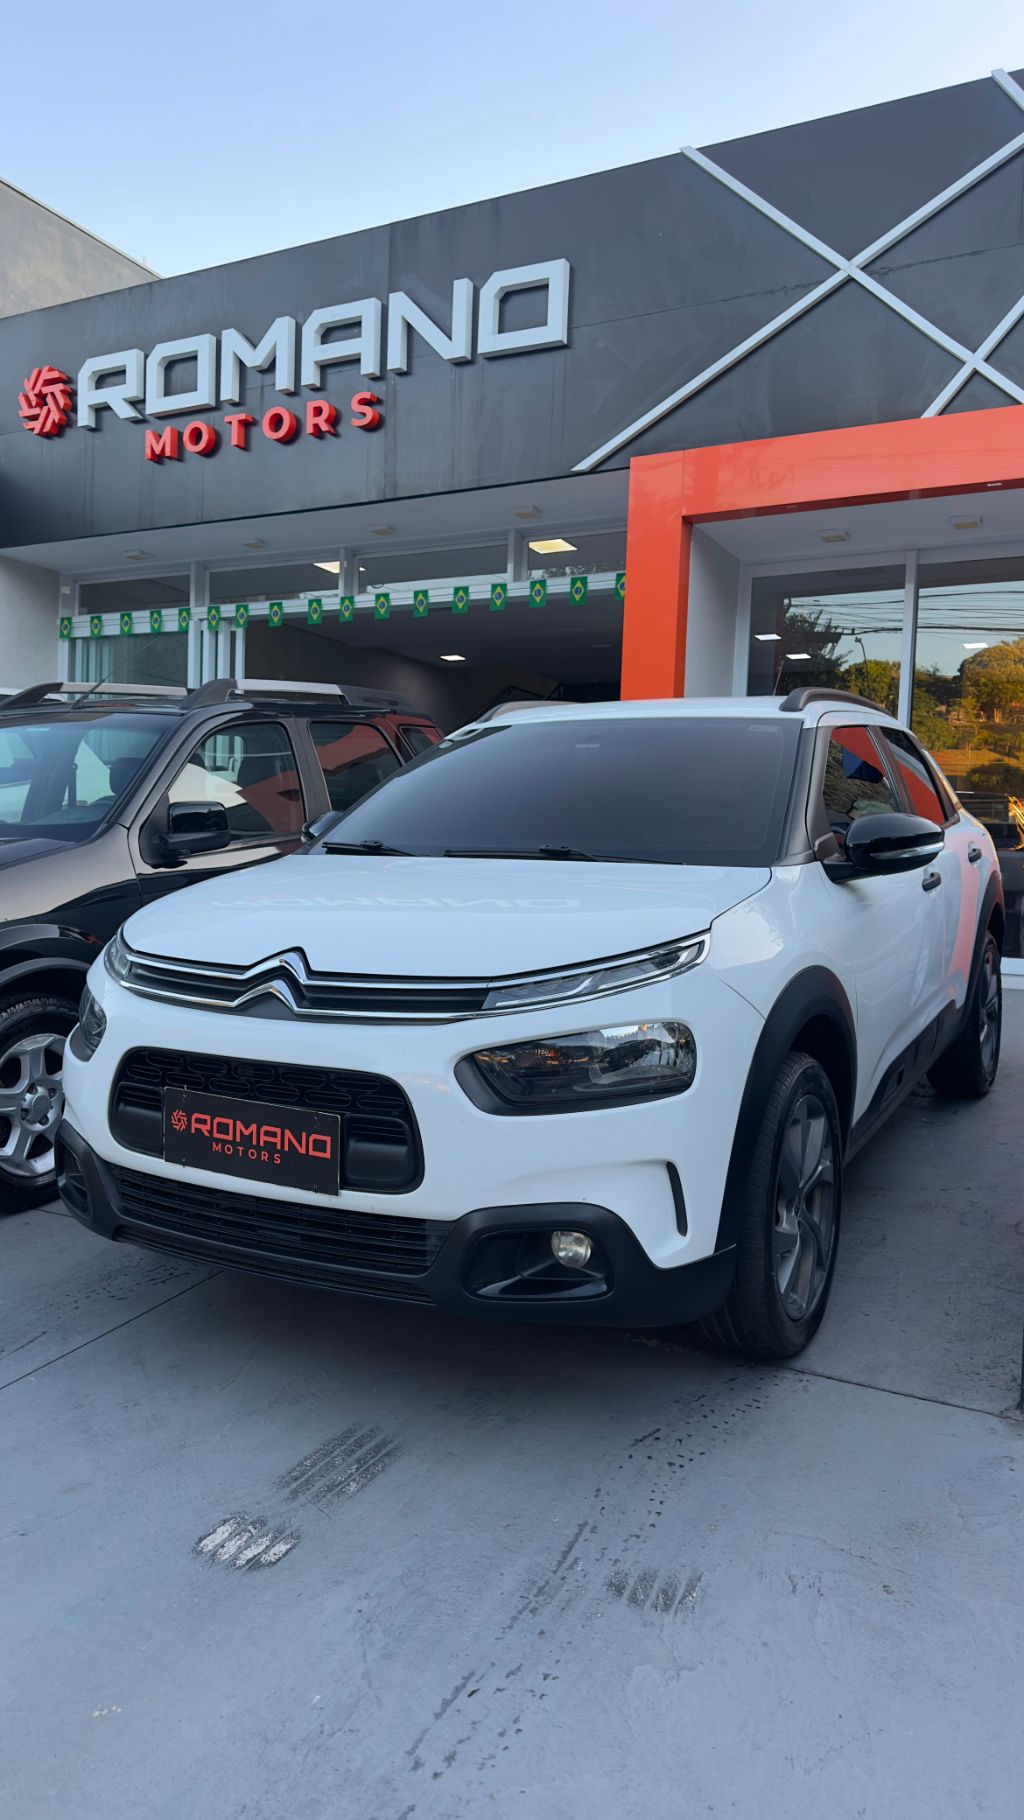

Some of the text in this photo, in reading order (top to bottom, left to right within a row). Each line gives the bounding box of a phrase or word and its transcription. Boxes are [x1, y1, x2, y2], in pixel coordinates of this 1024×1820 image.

[77, 258, 571, 428] ROMANO
[145, 391, 381, 462] MOTORS
[191, 1113, 331, 1159] ROMANO
[212, 1141, 281, 1164] MOTORS
